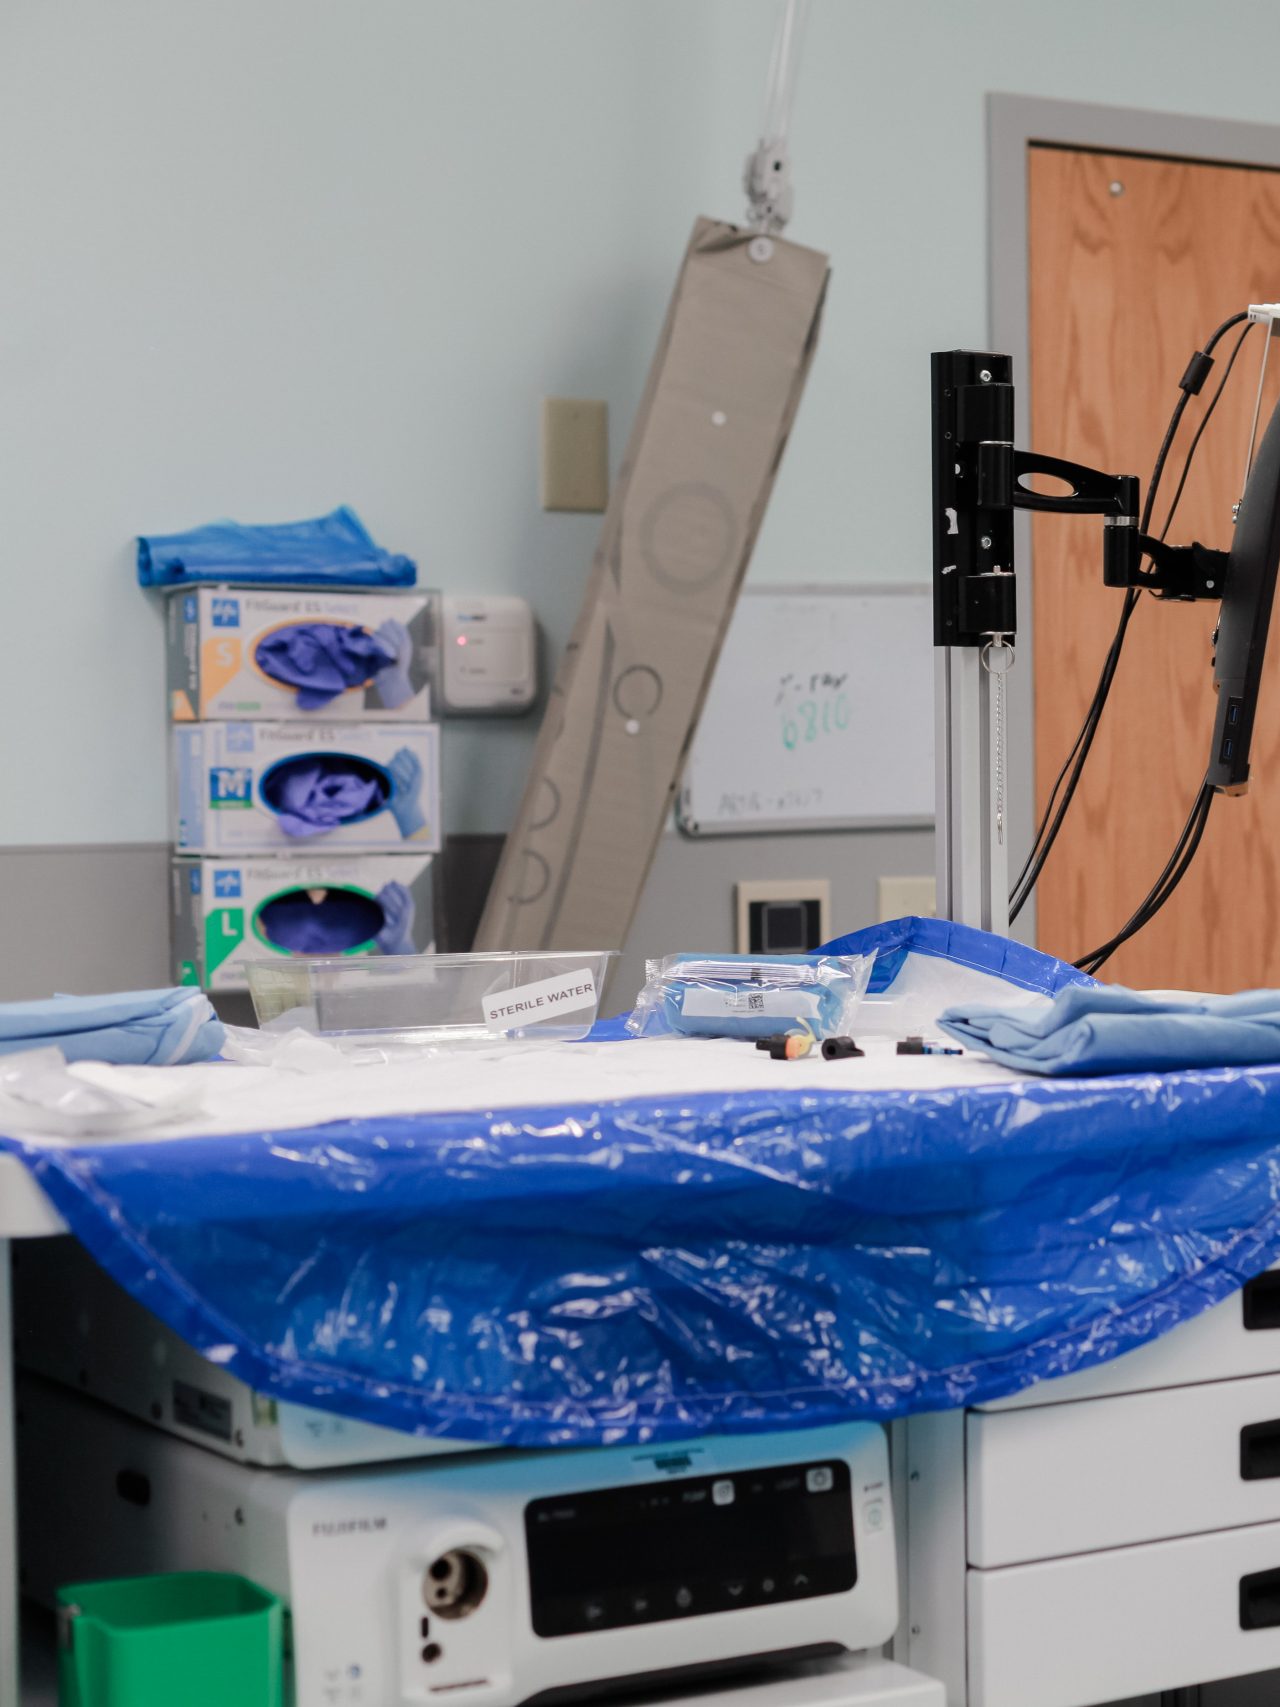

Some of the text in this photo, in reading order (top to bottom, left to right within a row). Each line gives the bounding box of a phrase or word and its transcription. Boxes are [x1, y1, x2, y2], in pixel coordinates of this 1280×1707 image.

[216, 641, 233, 667] S
[218, 771, 244, 798] M
[221, 911, 237, 936] L
[490, 983, 594, 1020] STERILE WATER
